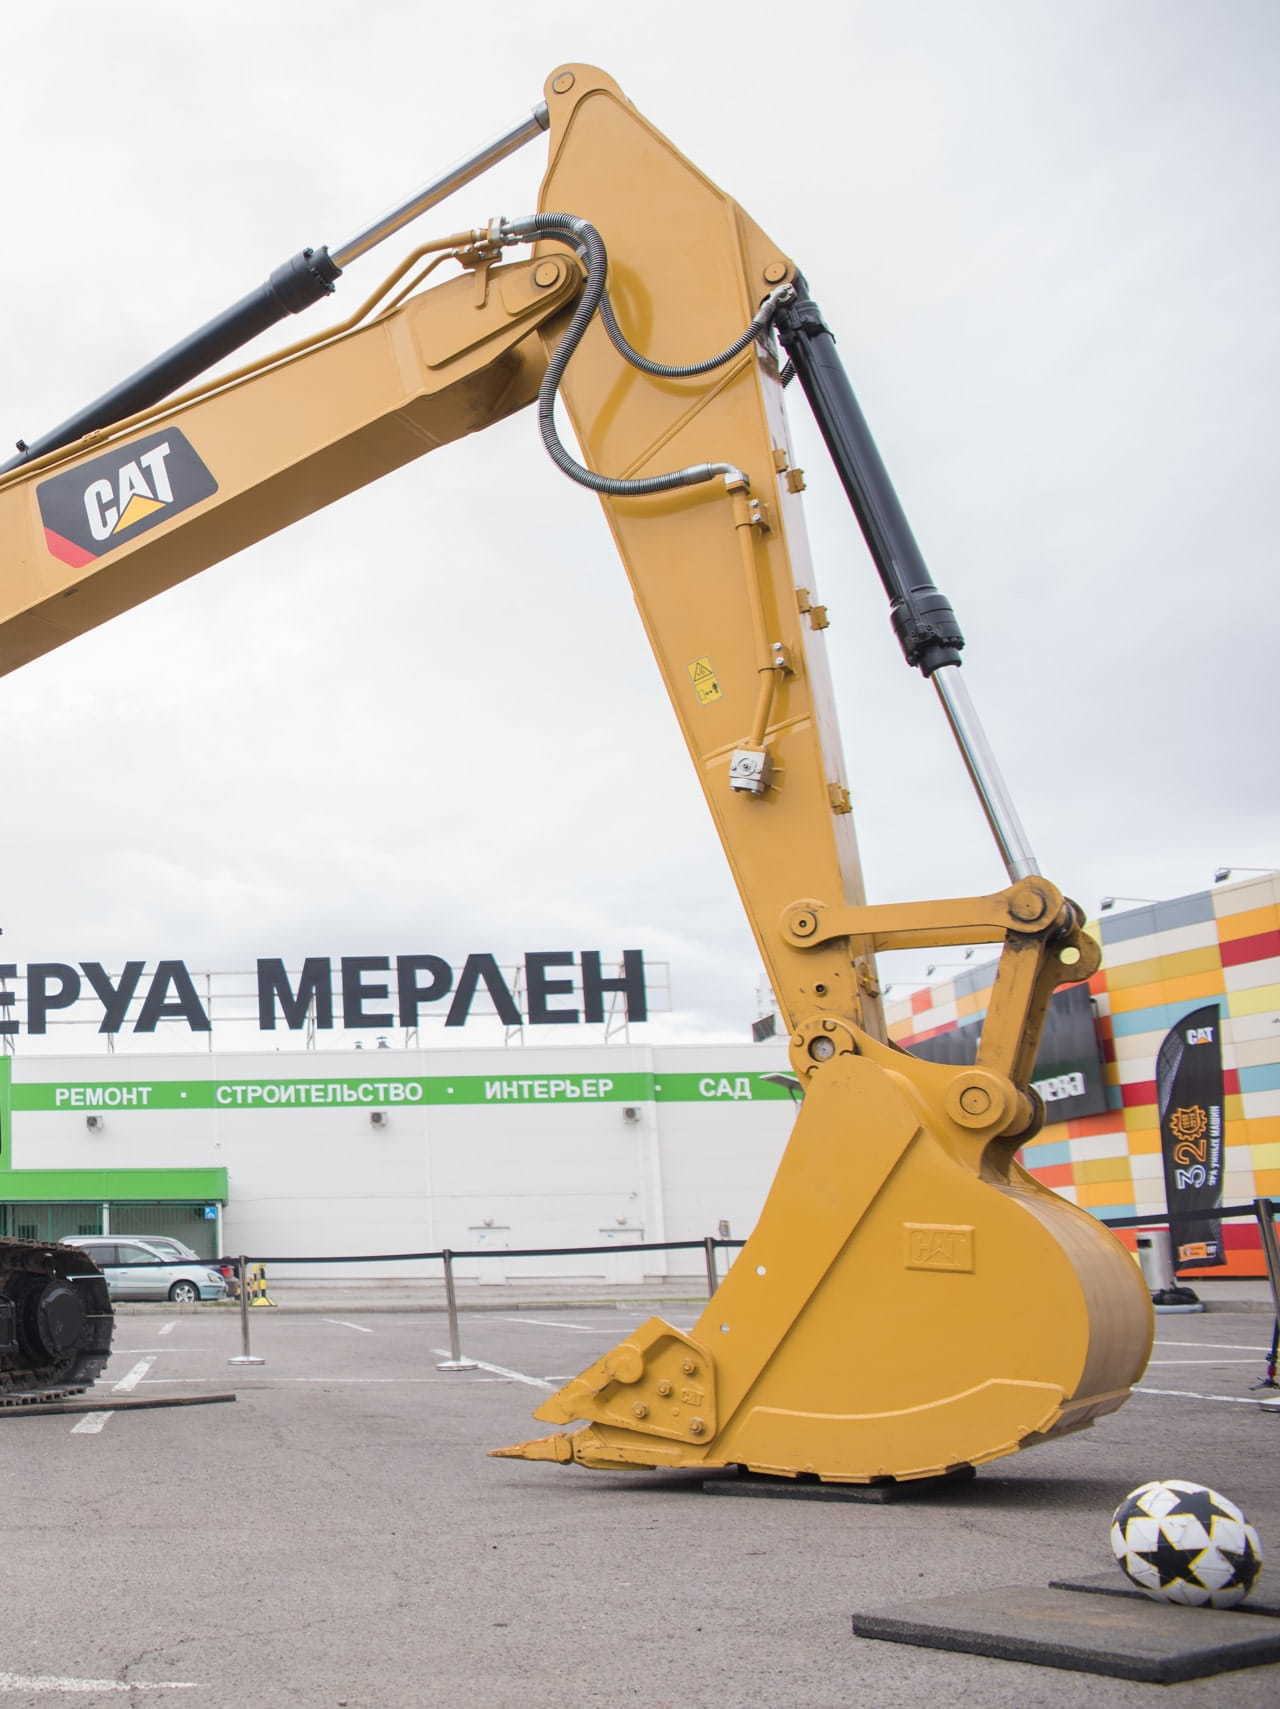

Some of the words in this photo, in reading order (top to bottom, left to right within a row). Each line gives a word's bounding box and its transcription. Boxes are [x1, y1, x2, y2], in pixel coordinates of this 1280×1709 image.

[84, 442, 174, 540] CAT
[257, 949, 648, 1031] МЕРЛЕН
[1186, 1026, 1214, 1045] CAT
[54, 1087, 153, 1107] РЕМОНТ
[215, 1082, 424, 1105] СТРОИТЕЛЬСТВО
[484, 1079, 614, 1100] ИНТЕРЬЕР
[698, 1078, 753, 1100] САД
